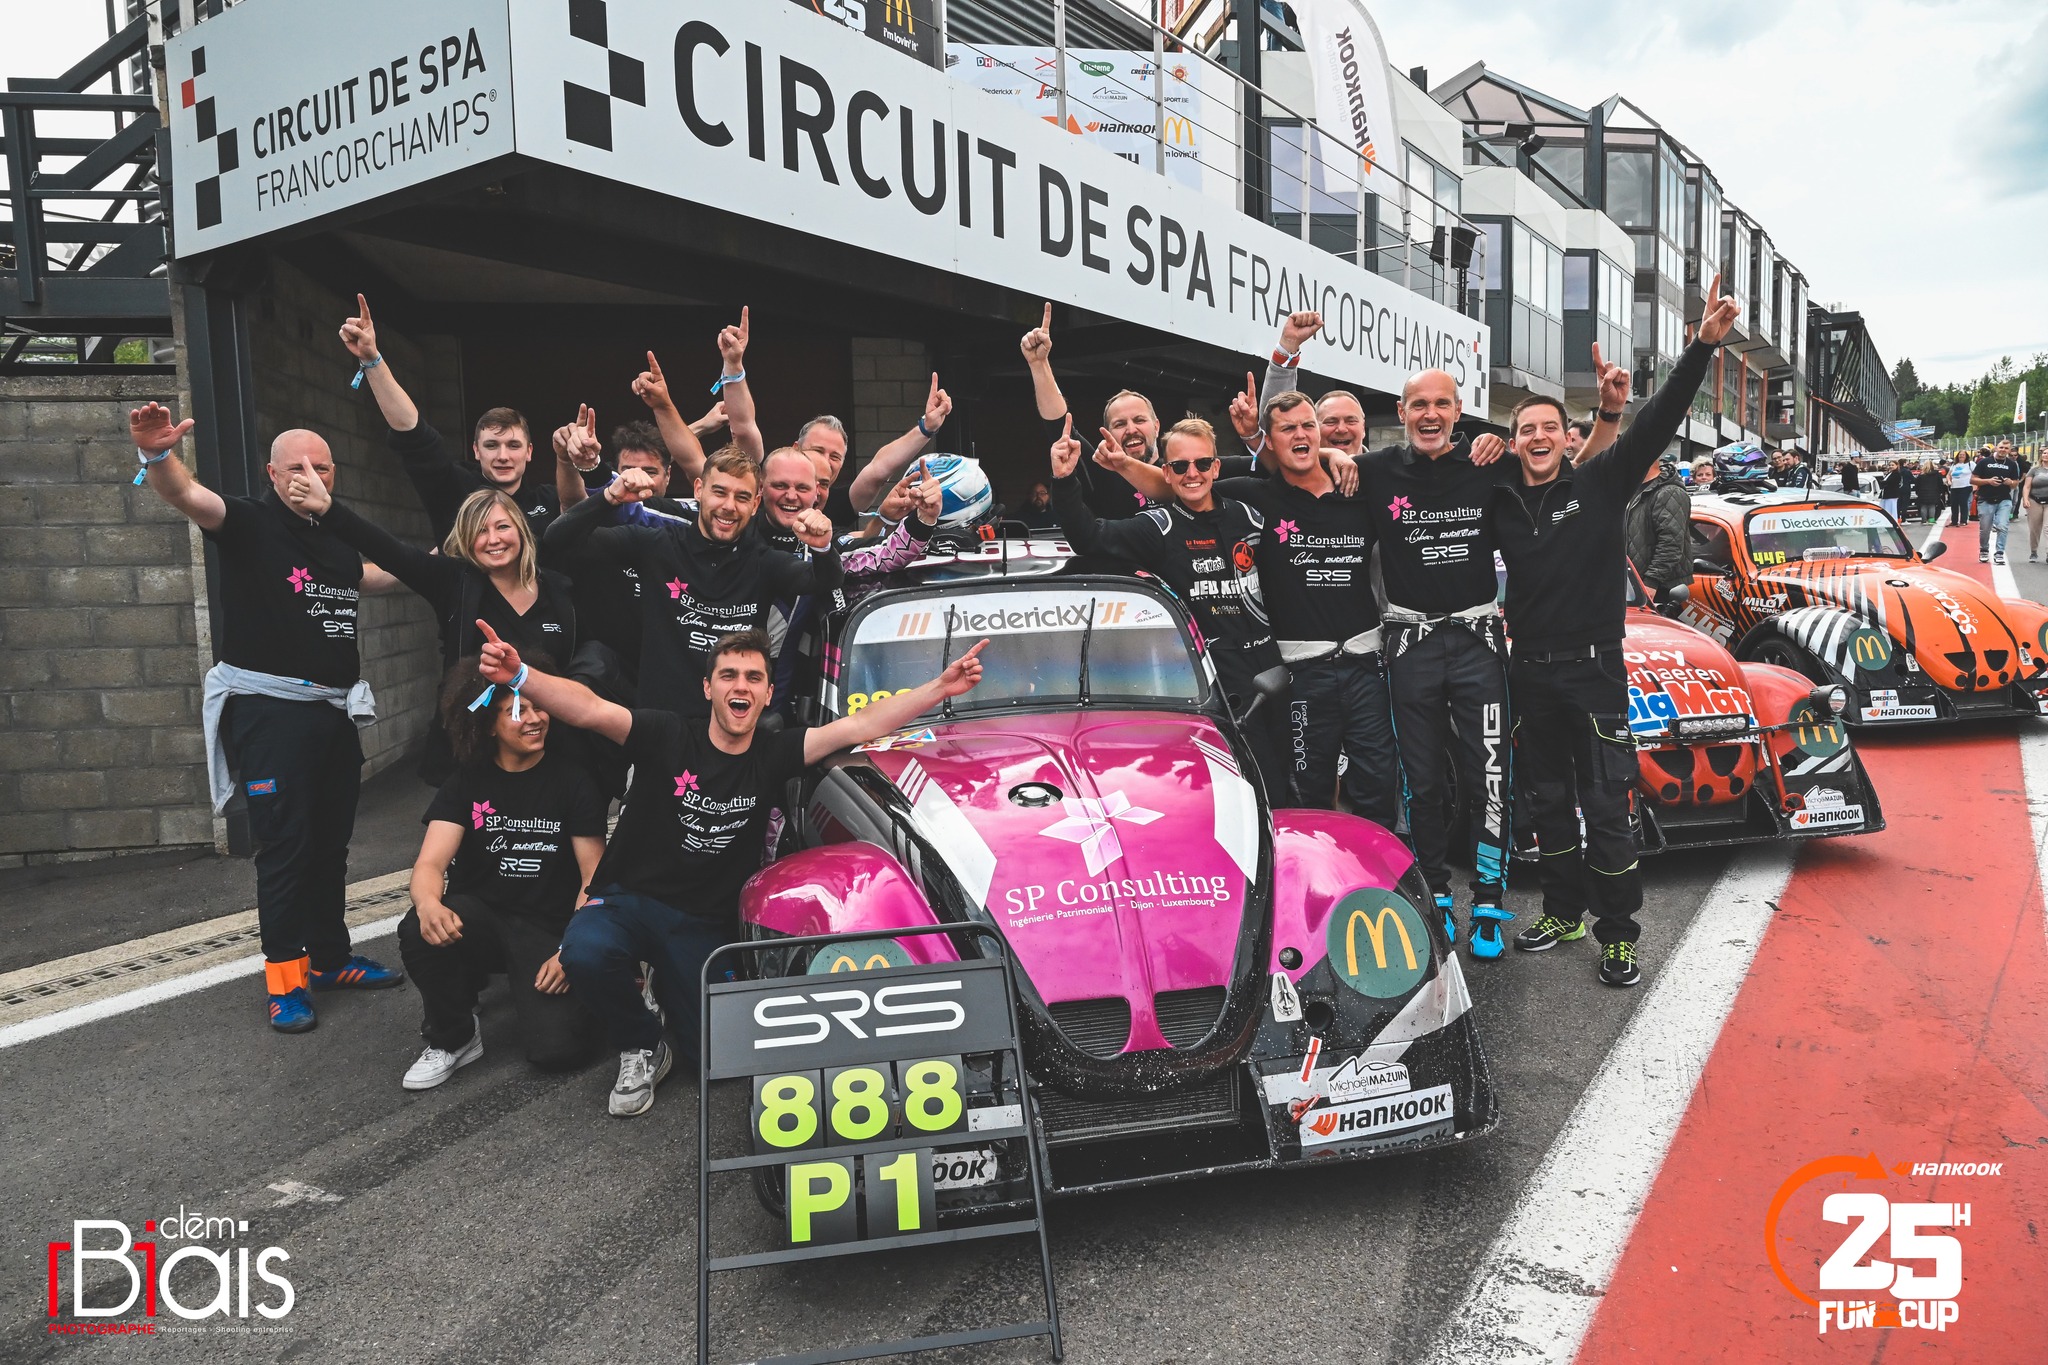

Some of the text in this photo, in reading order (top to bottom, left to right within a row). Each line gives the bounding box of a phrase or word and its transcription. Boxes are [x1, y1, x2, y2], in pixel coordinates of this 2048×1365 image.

[252, 27, 486, 160] CIRCUIT DE SPA
[674, 20, 1016, 239] CIRCUIT
[1039, 163, 1110, 275] DE
[1126, 205, 1216, 309] SPA
[1402, 507, 1483, 520] SP Consulting
[1781, 516, 1849, 530] DiederickX
[1290, 534, 1304, 544] SP
[1307, 534, 1365, 547] Consulting
[1421, 544, 1469, 560] SRS
[1753, 551, 1786, 565] 446
[1306, 569, 1352, 581] SRS
[304, 582, 317, 593] SP
[680, 593, 695, 606] SP
[942, 603, 1088, 632] DiederickX
[1751, 606, 1780, 614] RACING
[690, 631, 719, 647] SR
[1624, 650, 1687, 667] oxy
[1290, 700, 1309, 772] Lemoine
[684, 791, 700, 804] SP
[486, 816, 501, 827] SP
[1005, 871, 1231, 915] SP Consulting
[1010, 910, 1054, 928] Ingénierie
[1056, 902, 1113, 919] Patrimoniale
[1130, 899, 1155, 912] Dijon
[1161, 896, 1216, 911] Luxembourg
[753, 980, 965, 1050] SRS
[759, 1060, 963, 1148] 888
